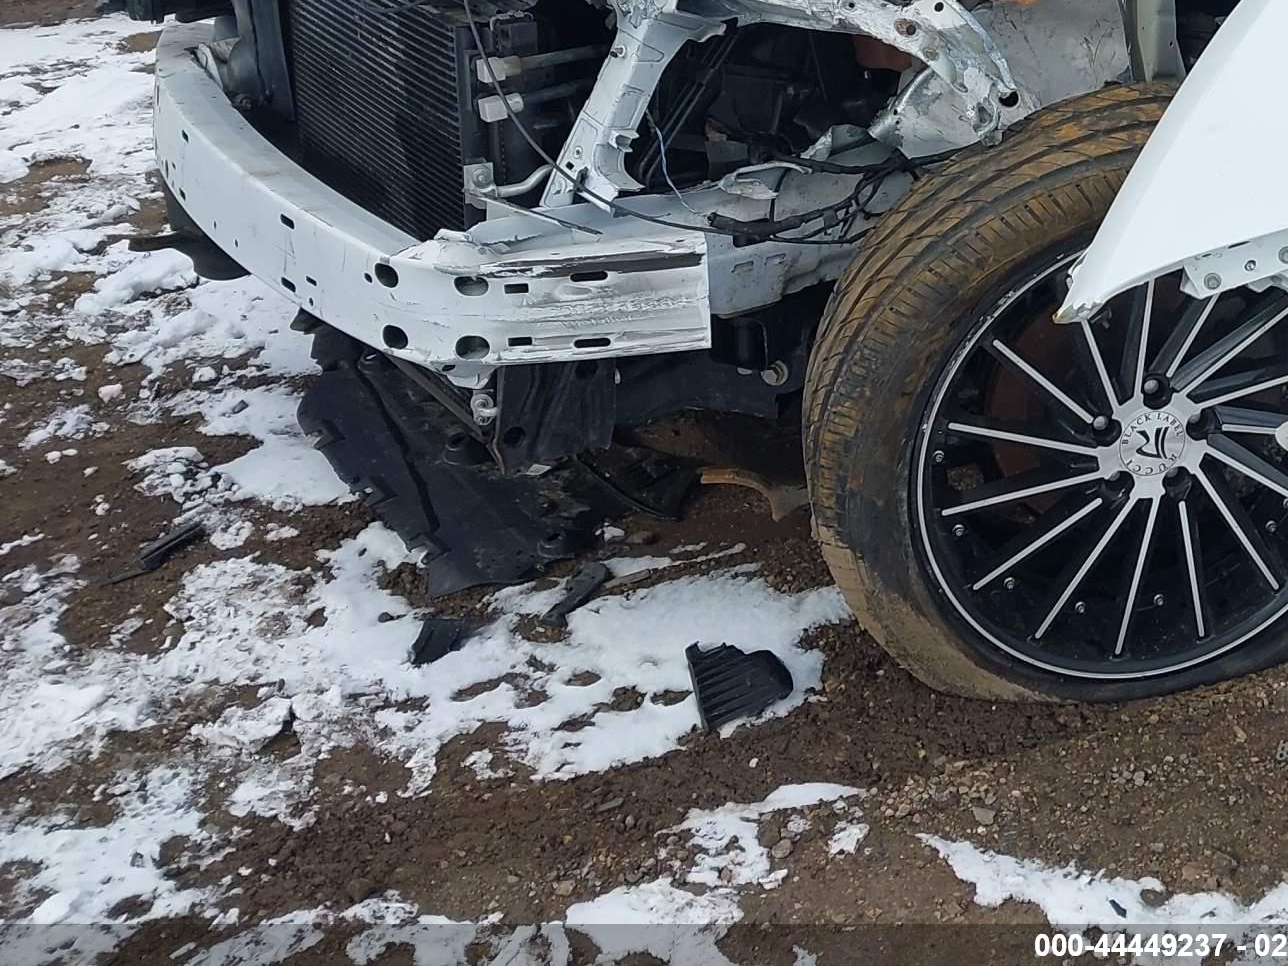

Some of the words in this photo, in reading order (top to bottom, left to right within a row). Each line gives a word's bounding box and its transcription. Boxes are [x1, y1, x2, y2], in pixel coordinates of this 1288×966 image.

[1121, 413, 1151, 445] BLACK
[1157, 412, 1184, 437] LABEL
[1126, 453, 1177, 475] RUCCI
